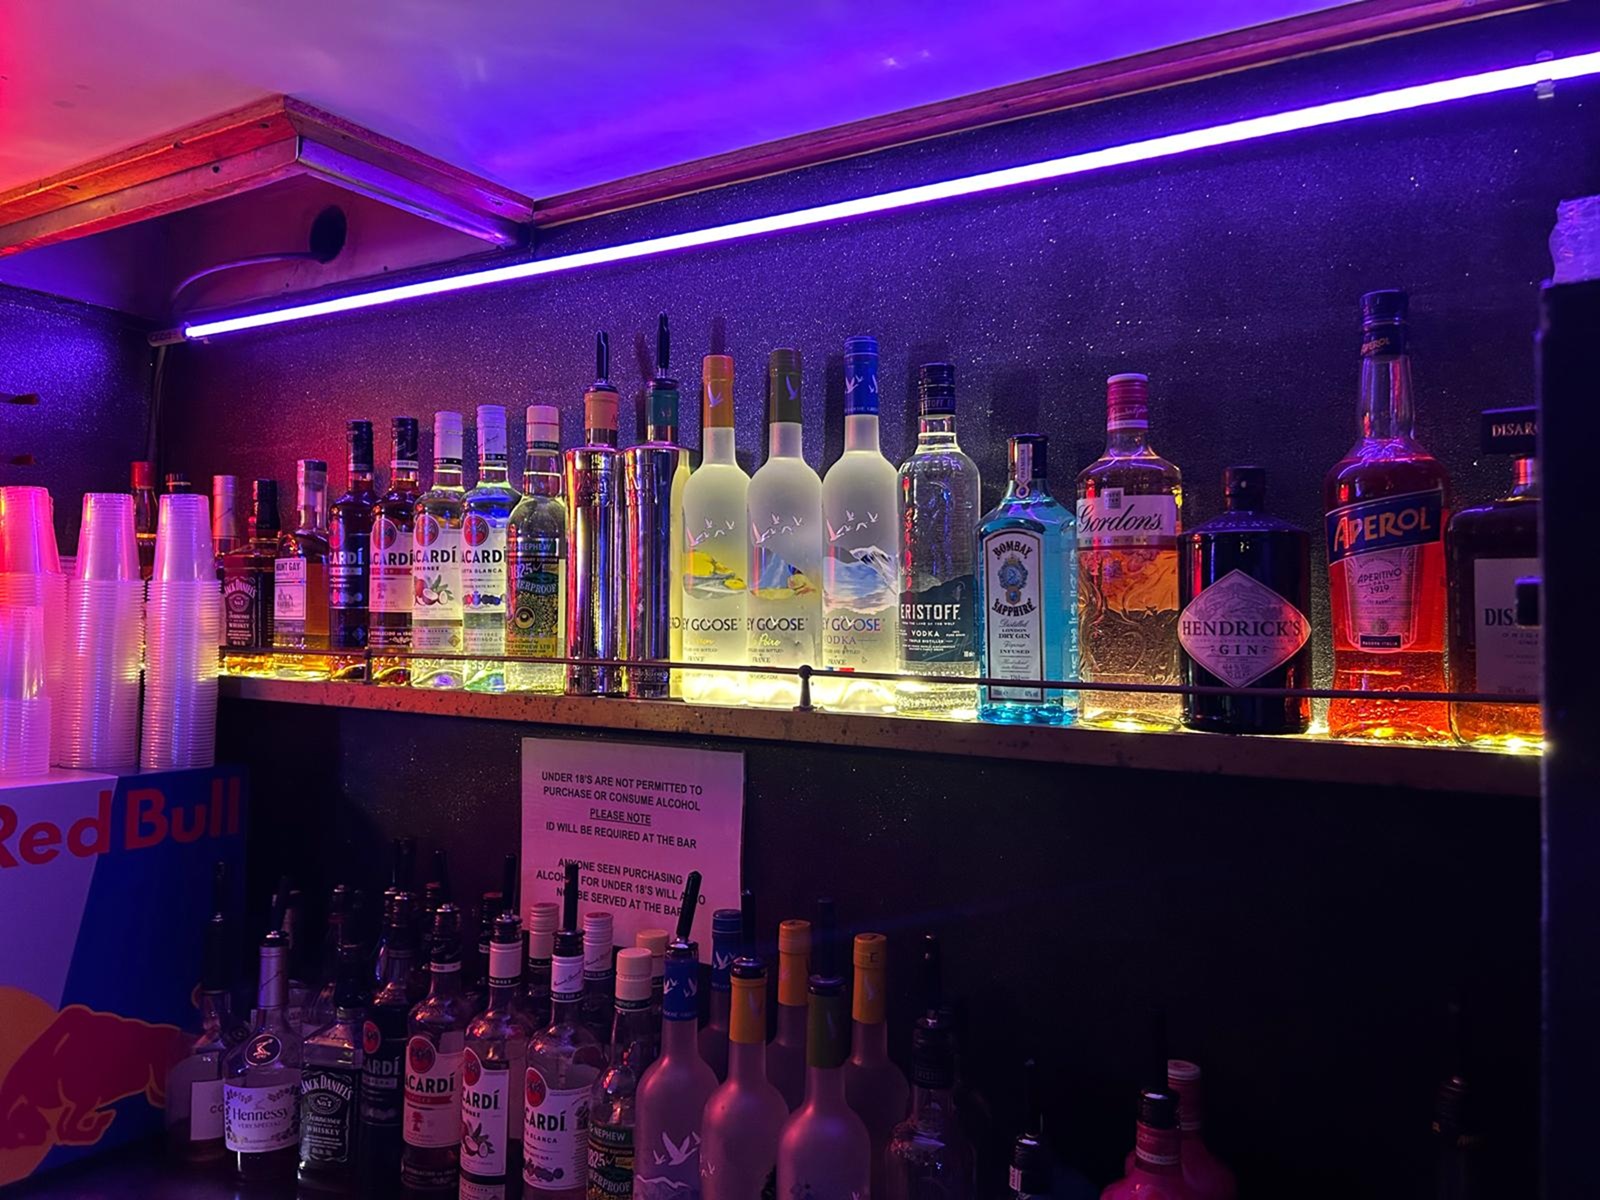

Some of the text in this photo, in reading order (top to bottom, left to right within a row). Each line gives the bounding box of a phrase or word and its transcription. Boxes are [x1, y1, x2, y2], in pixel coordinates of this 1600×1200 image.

[1491, 420, 1537, 438] DISAR
[1078, 503, 1163, 534] Gordon's
[1333, 506, 1431, 552] APEROL
[992, 540, 1033, 560] BOMBAY
[1357, 567, 1402, 585] APERITIVO
[991, 597, 1037, 617] SAPPHIRE
[1484, 607, 1513, 626] DIS
[691, 617, 738, 631] GOOSE
[756, 617, 805, 631] GOOSE
[832, 617, 880, 631] GOOSE
[1182, 620, 1301, 637] HENDRICK'S
[1219, 644, 1258, 655] GIN
[541, 771, 703, 796] UNDER 18'S ARE NOT PERMITTED TO
[543, 786, 701, 812] PURCHASE OR CONSUME ALCOHOL
[0, 776, 240, 869] Red Bull
[590, 808, 652, 826] PLEASE NOTE
[546, 821, 697, 849] ID WILL BE REQUIRED AT THE BAR
[596, 862, 621, 876] SEEN
[622, 866, 683, 885] PURCHASING
[581, 876, 600, 887] FOR
[601, 878, 633, 892] UNDER
[635, 884, 653, 896] 18'S
[655, 887, 678, 900] WILL
[578, 890, 589, 902] BE
[591, 892, 627, 908] SERVED
[629, 898, 642, 910] AT
[643, 902, 662, 914] THE
[233, 1108, 288, 1121] Hennessy
[594, 1126, 626, 1142] NEPHEW
